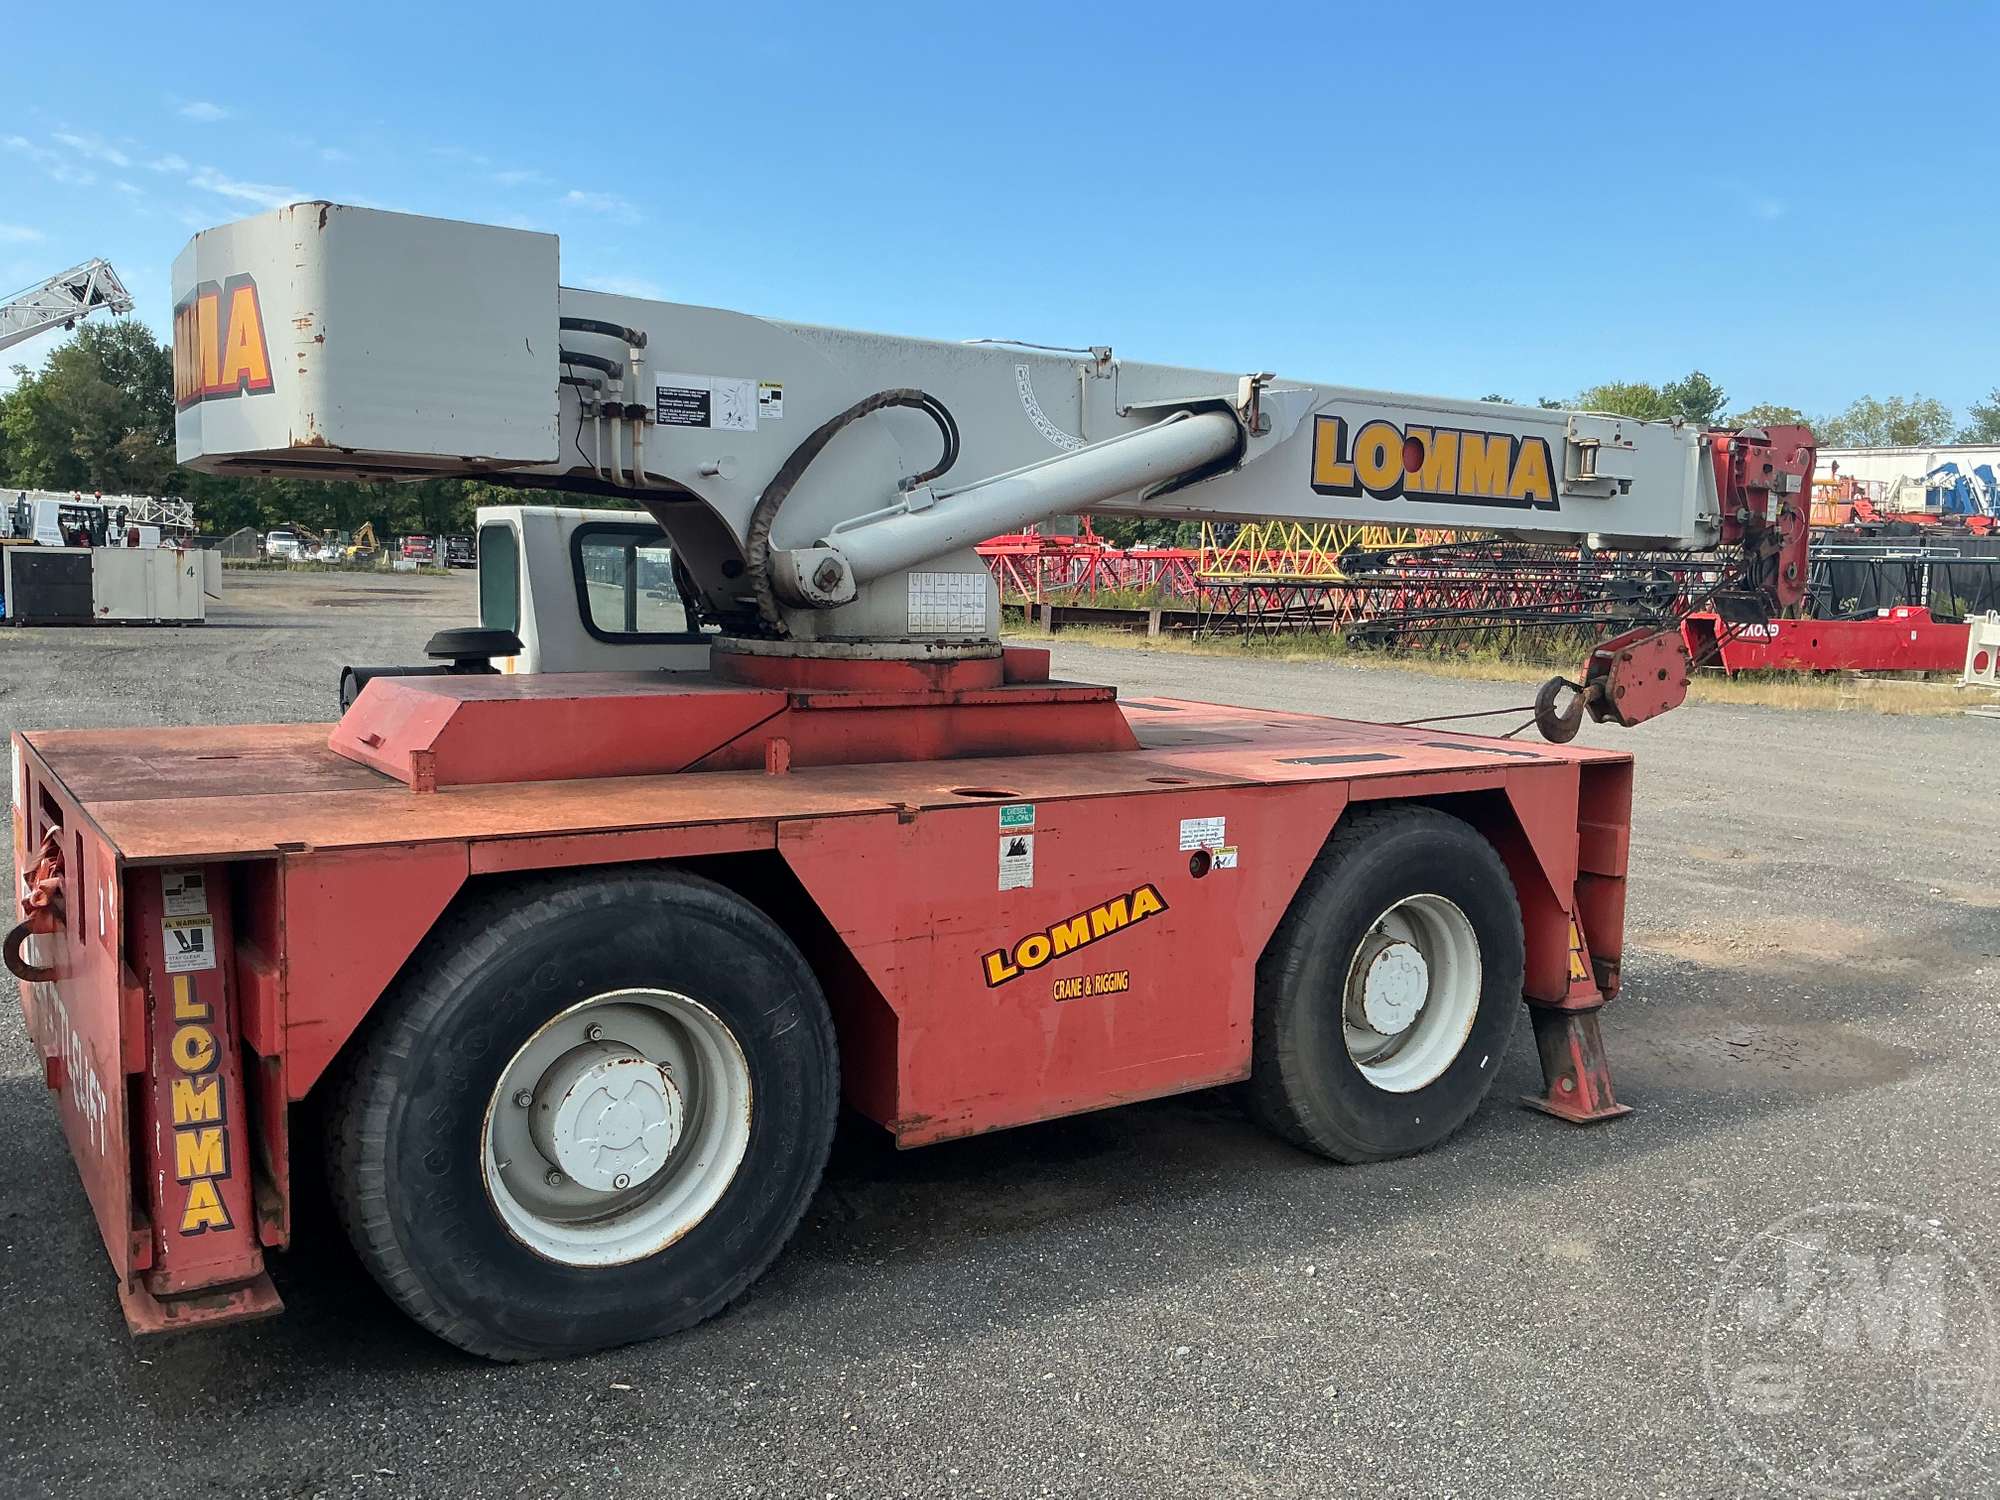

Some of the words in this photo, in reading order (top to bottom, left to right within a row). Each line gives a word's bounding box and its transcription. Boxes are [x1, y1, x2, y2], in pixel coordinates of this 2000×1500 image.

[1311, 414, 1560, 511] LOMMA
[186, 565, 195, 579] 4
[175, 918, 211, 928] WARNING
[982, 884, 1169, 987] LOMMA
[183, 953, 201, 961] CLEAR
[1053, 977, 1084, 1001] CRANE
[1085, 977, 1092, 996] &
[1094, 970, 1129, 995] RIGGING
[172, 975, 234, 1237] LOMMA
